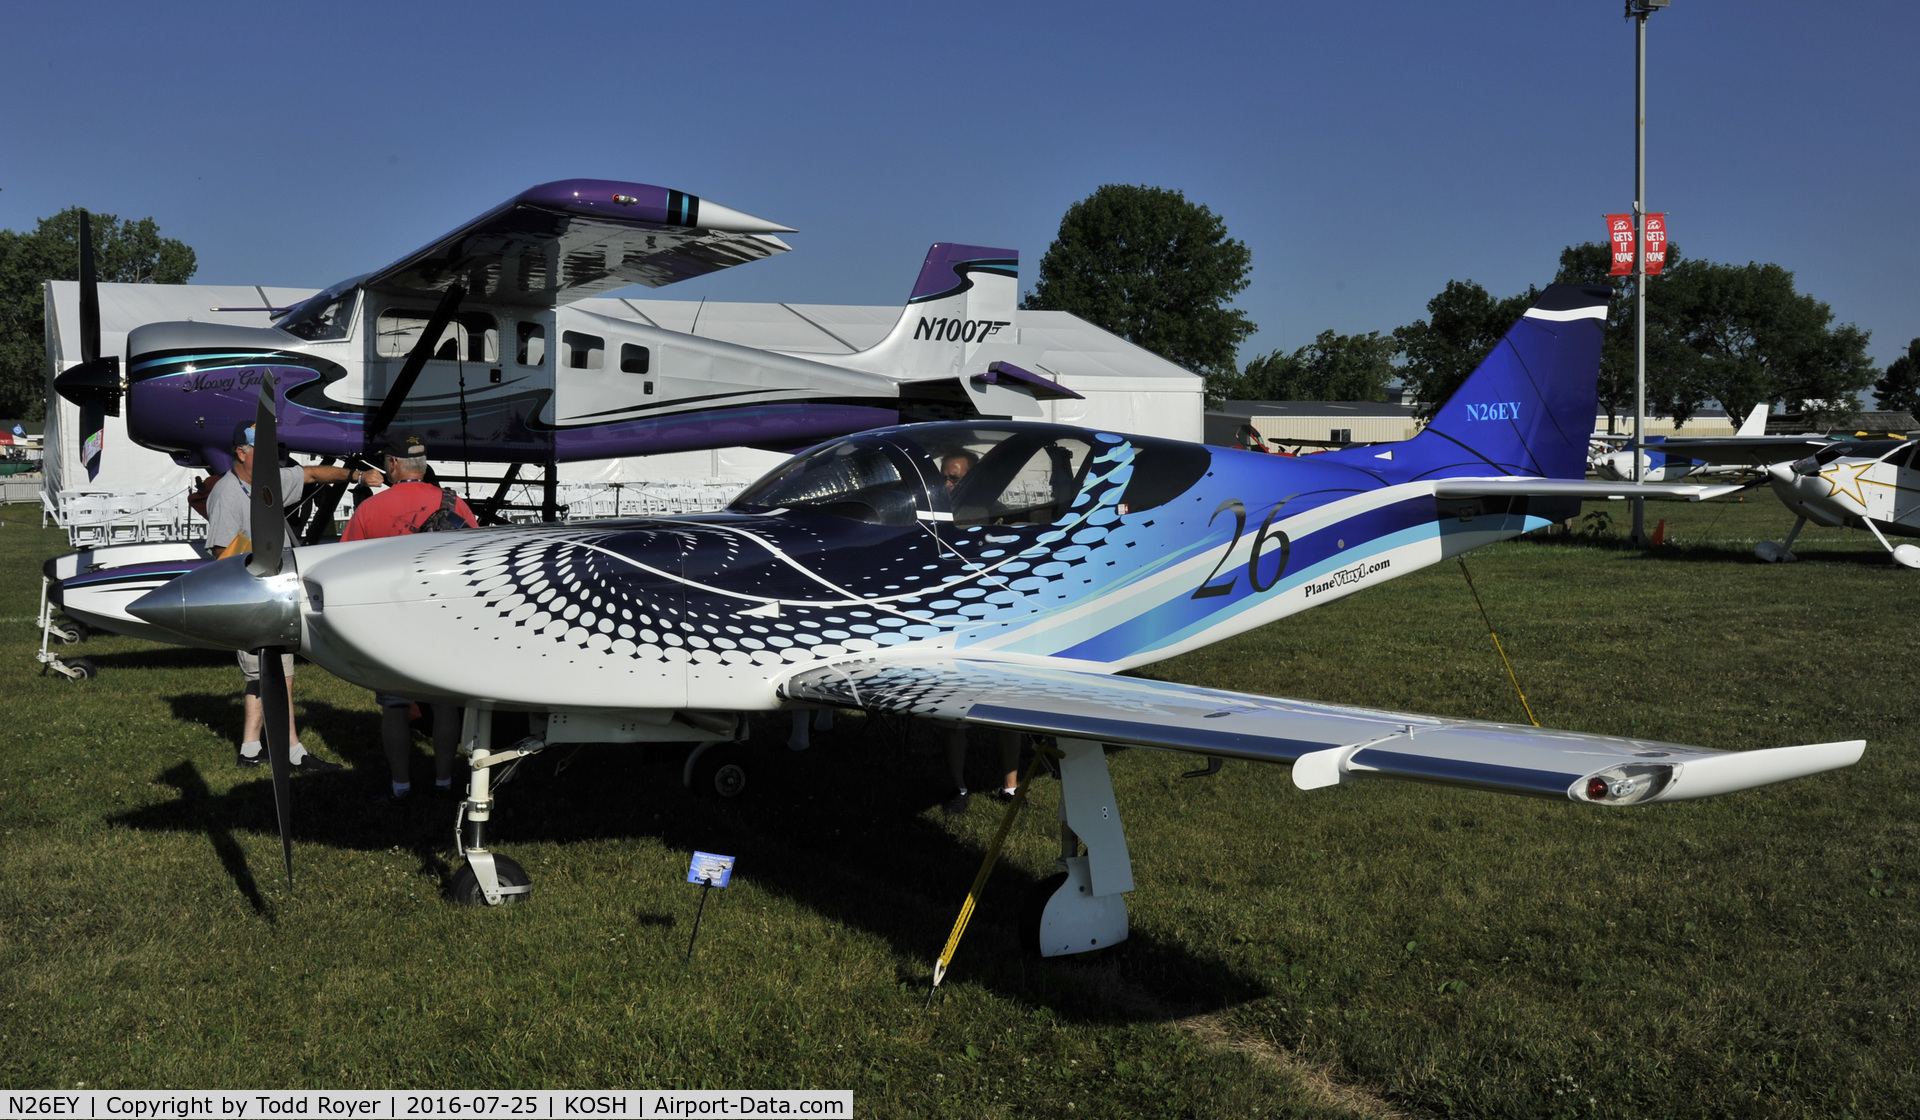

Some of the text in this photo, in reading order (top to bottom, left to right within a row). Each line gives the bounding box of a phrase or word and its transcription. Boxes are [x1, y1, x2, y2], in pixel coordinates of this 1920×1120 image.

[1613, 231, 1633, 242] GETS
[1646, 231, 1665, 242] GETS
[1620, 242, 1628, 252] IT
[1652, 242, 1660, 252] IT
[1615, 252, 1634, 263] DONE
[1646, 252, 1665, 262] DONE
[183, 369, 281, 393] Moosey Gale
[1465, 401, 1522, 422] N26EY
[1190, 492, 1301, 600] 26
[1304, 559, 1391, 598] PlaneVinyl.com
